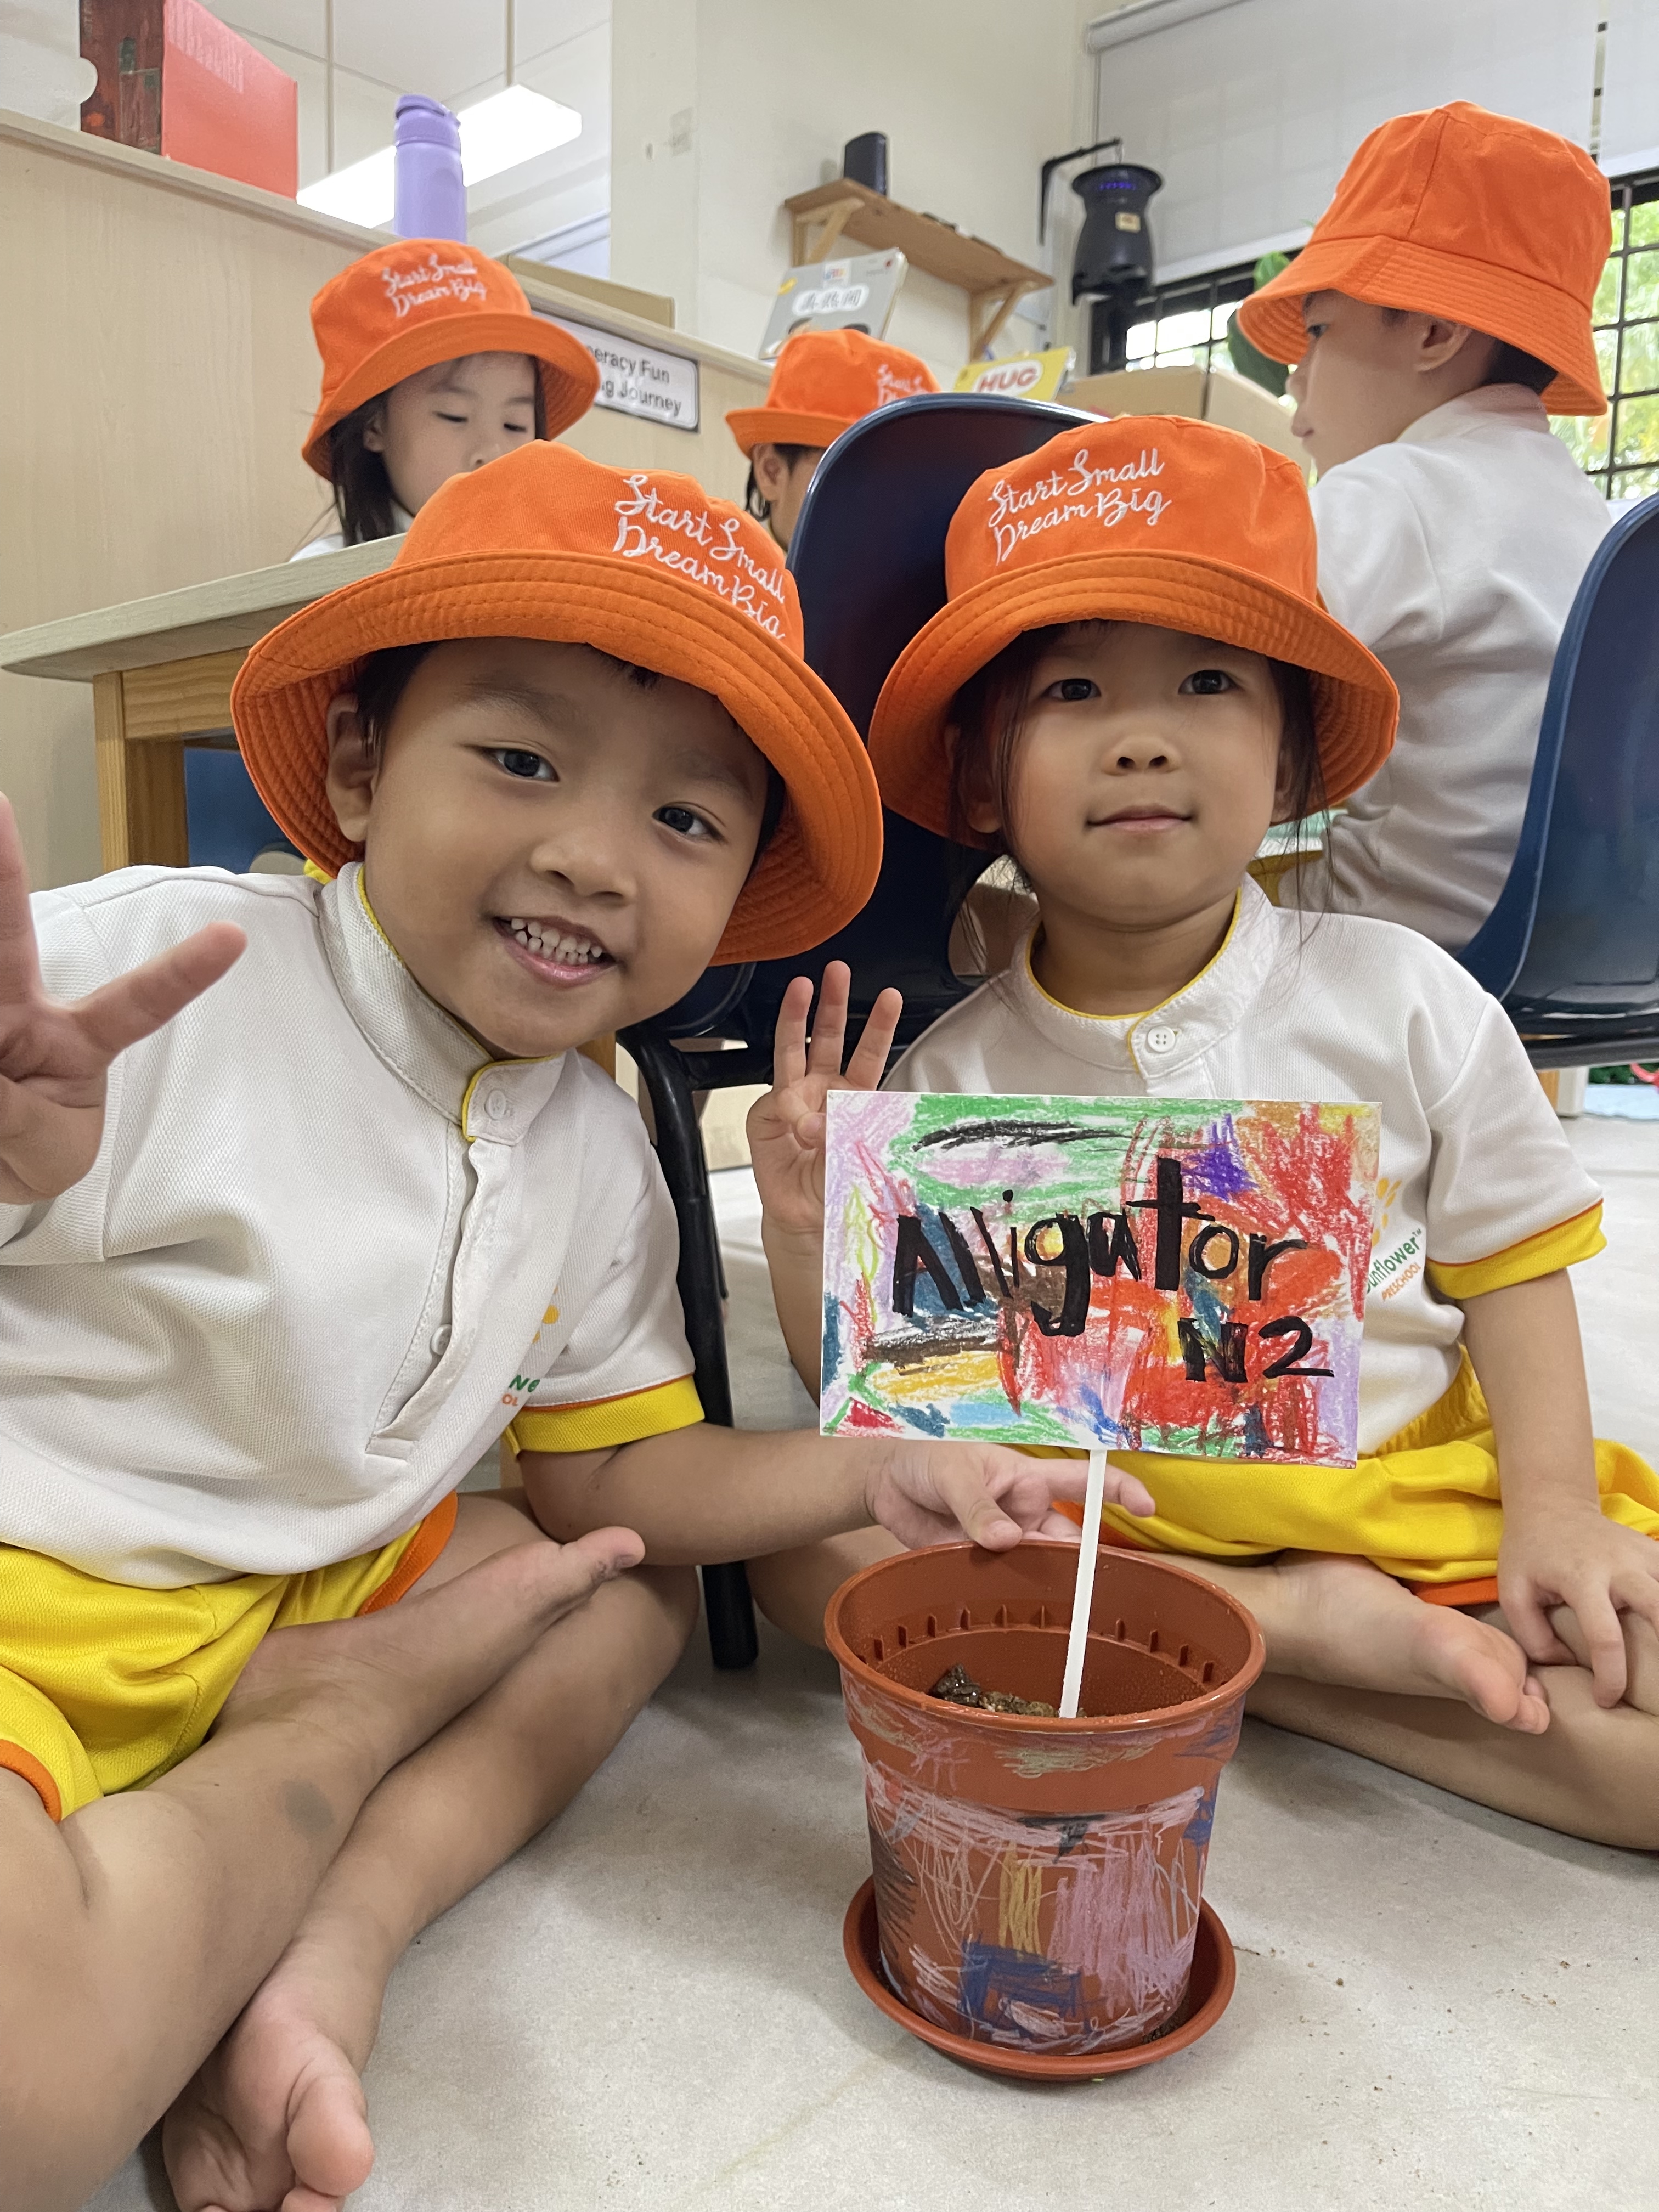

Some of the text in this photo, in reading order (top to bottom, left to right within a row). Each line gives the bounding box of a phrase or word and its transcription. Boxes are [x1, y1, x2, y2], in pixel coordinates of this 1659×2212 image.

[383, 253, 477, 297] Start Small
[392, 278, 487, 317] Dream Big
[619, 380, 682, 417] Journey
[639, 359, 670, 384] Fun
[978, 368, 1038, 392] HUG
[988, 449, 1165, 527] Start Small
[612, 516, 730, 595] Dream
[614, 475, 786, 604] Start Small
[994, 488, 1172, 566] Dream Big
[893, 1156, 1308, 1337] Alligator
[1177, 1316, 1334, 1383] N2
